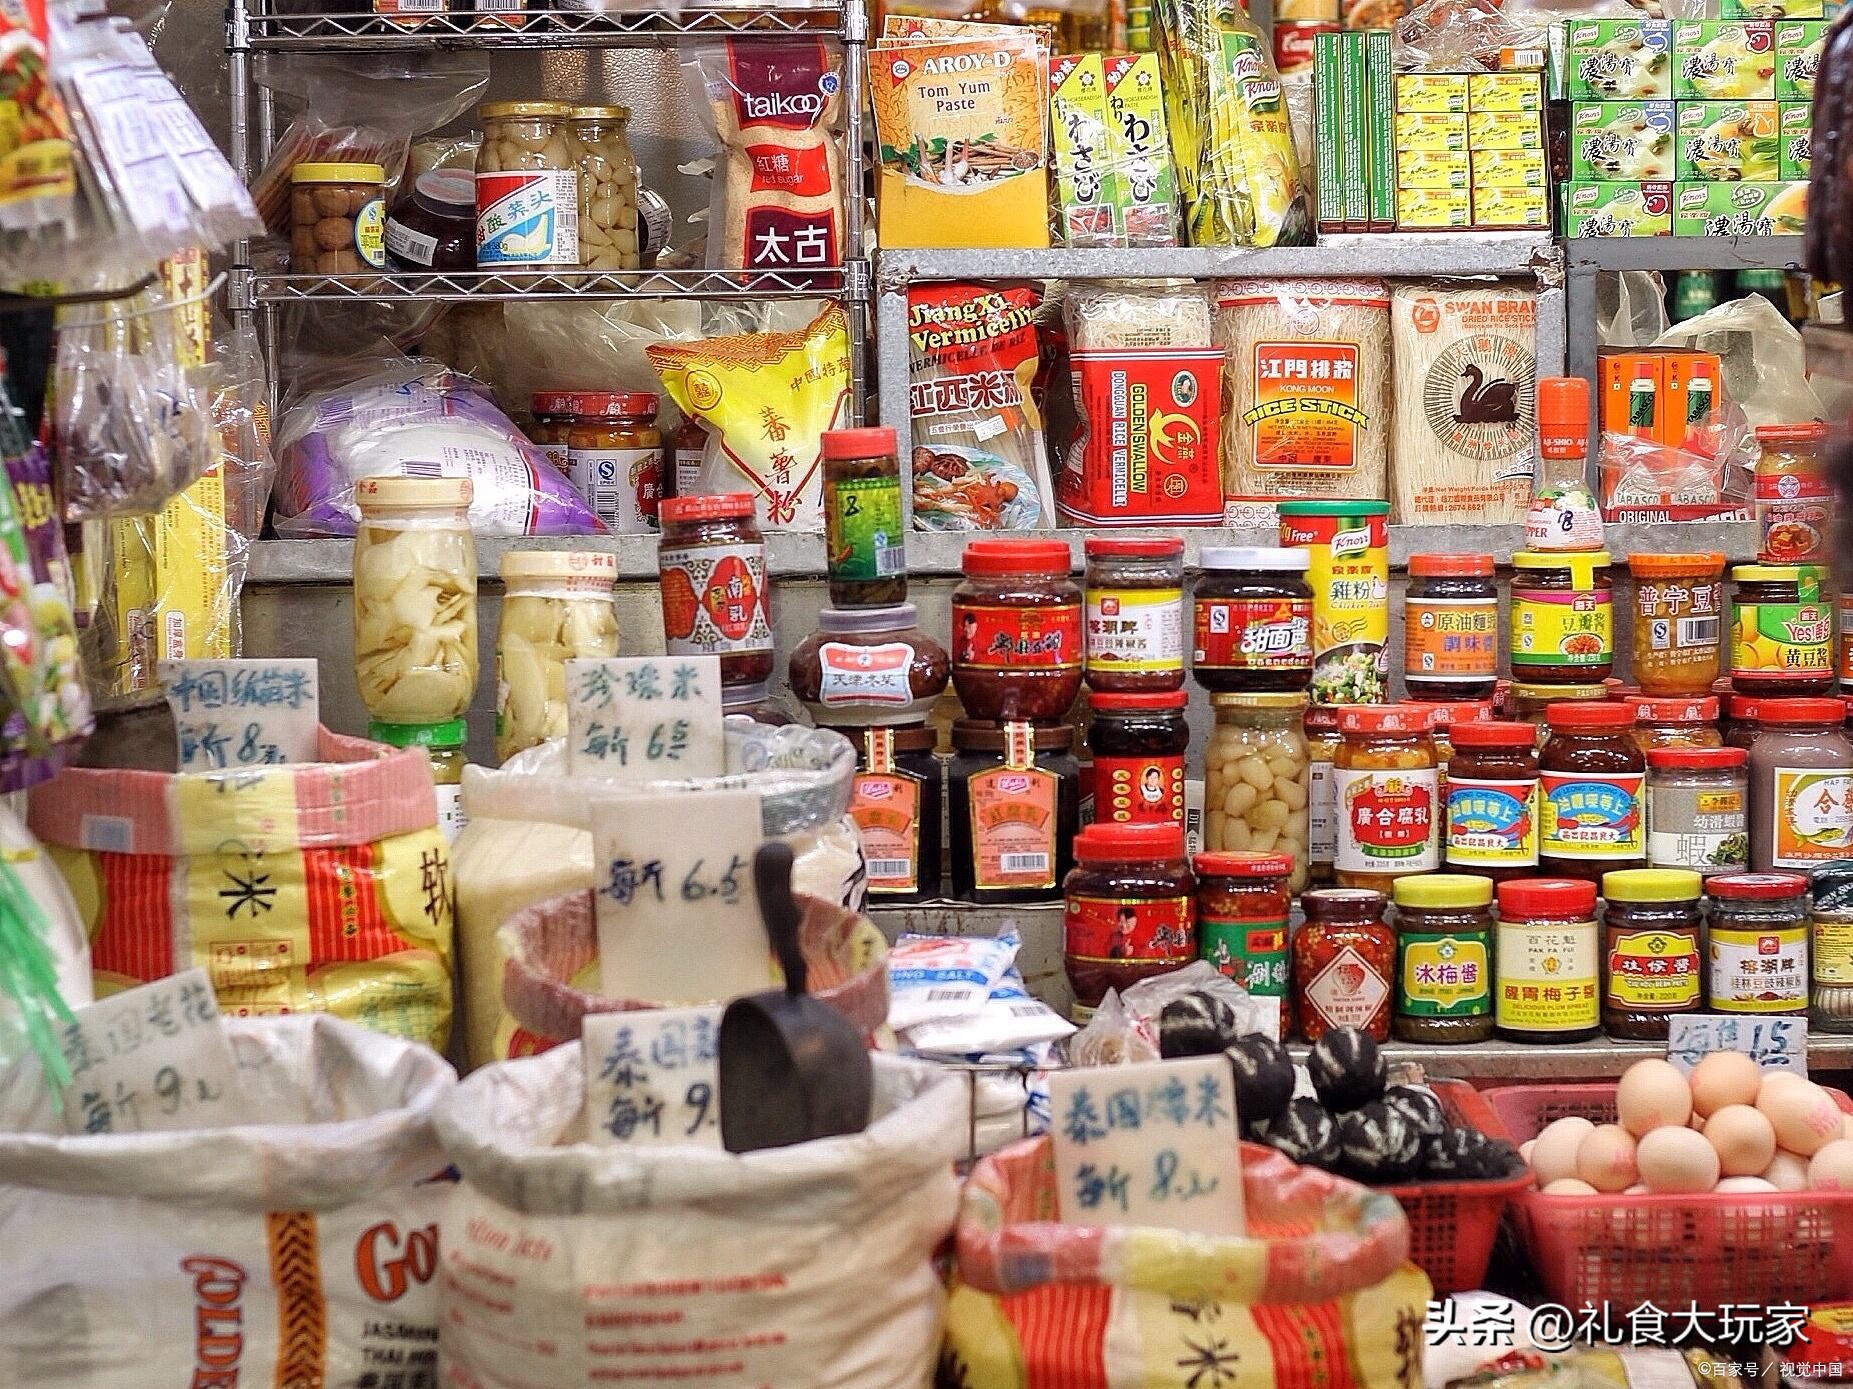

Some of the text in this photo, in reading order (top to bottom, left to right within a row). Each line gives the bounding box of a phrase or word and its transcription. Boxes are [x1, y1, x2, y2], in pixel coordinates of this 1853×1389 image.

[922, 50, 1013, 75] AROY-D
[917, 81, 990, 99] Tom Yum
[744, 92, 822, 118] taikoo
[936, 98, 976, 113] Paste
[756, 154, 790, 172] 红糖
[754, 225, 828, 263] 太古
[1444, 301, 1493, 314] SWAN
[1461, 315, 1488, 324] DRIED
[1260, 359, 1354, 380] 江門排粉
[1279, 385, 1335, 394] KONG MOON
[1242, 398, 1370, 431] RICE STICK
[1112, 371, 1128, 506] DONGGUAN RICE VERMICELLI
[1132, 384, 1147, 493] GOLDEN SWALLOW
[1620, 510, 1673, 524] ORIGINAL
[1291, 529, 1314, 543] Free
[1330, 580, 1370, 602] 雞粉
[1356, 806, 1430, 827] 廣合腐乳
[1675, 833, 1708, 867] 蝦
[219, 867, 277, 921] 米
